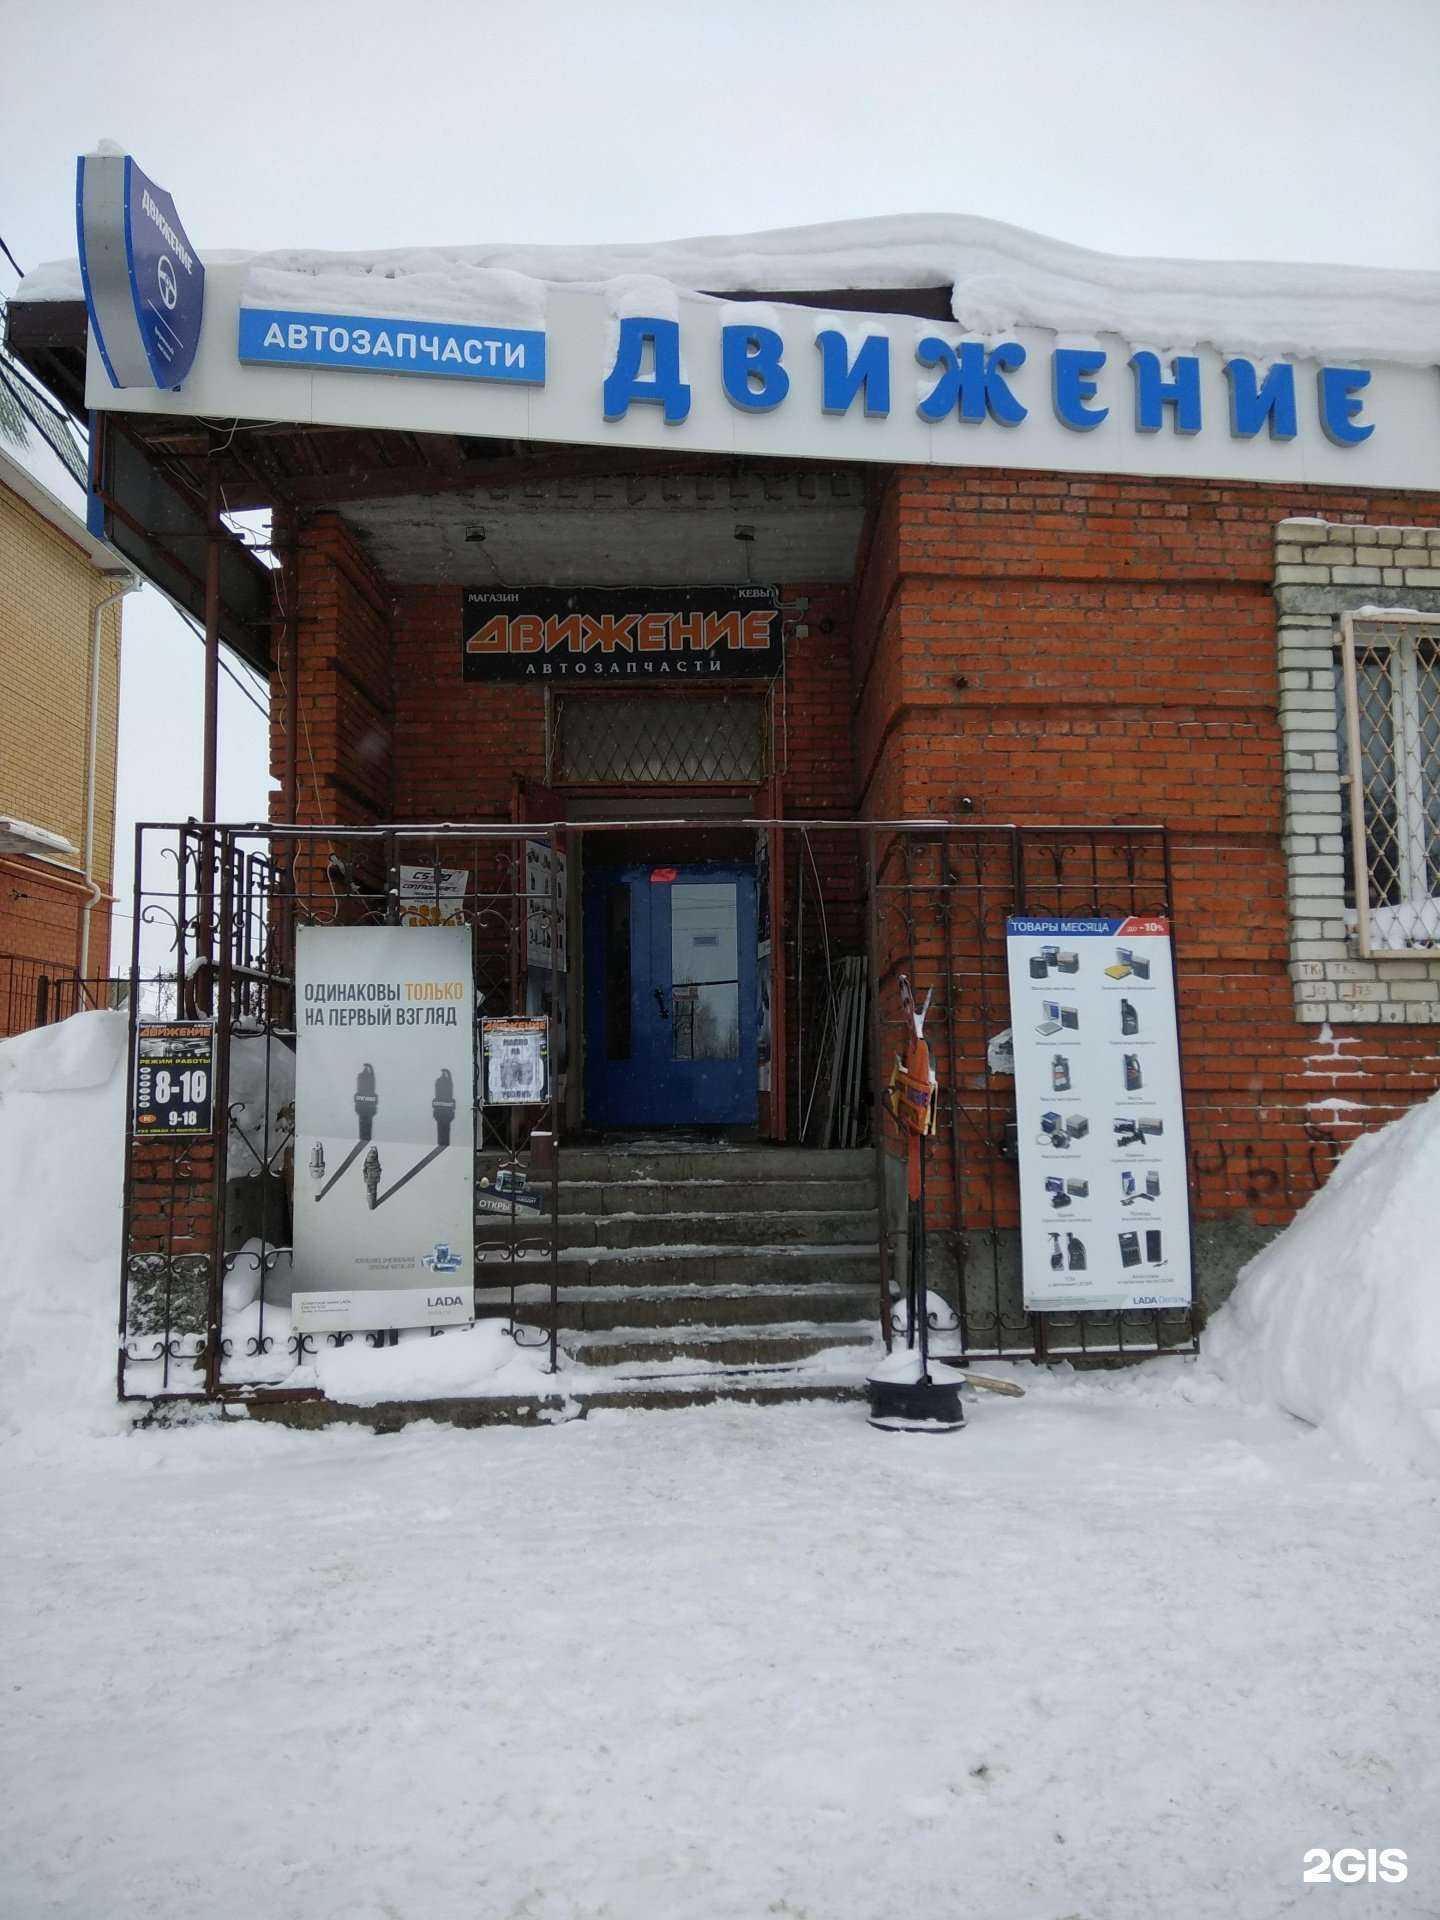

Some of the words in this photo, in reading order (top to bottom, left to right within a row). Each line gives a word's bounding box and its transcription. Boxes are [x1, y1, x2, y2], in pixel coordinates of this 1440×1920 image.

[142, 189, 193, 275] ДВИЖЕНИЕ
[263, 322, 526, 368] АВТОЗАПЧАСТИ
[603, 316, 1376, 448] ДВИЖЕНИЕ
[468, 592, 520, 602] МАГАЗИН
[466, 610, 779, 654] ДВИЖЕНИЕ
[525, 660, 722, 674] АВТОЗАПЧАСТИ
[1012, 922, 1059, 932] ТОВАРЫ
[1061, 922, 1110, 933] МЕСЯЦА
[304, 983, 401, 1003] ОДИНАКОВЫ
[405, 981, 465, 1000] ТОЛЬКО
[305, 1008, 324, 1026] НА
[329, 1004, 392, 1026] ПЕРВЫЙ
[396, 1006, 458, 1026] ВЗГЛЯД
[427, 1296, 464, 1307] LADA
[1133, 1295, 1158, 1305] LADA
